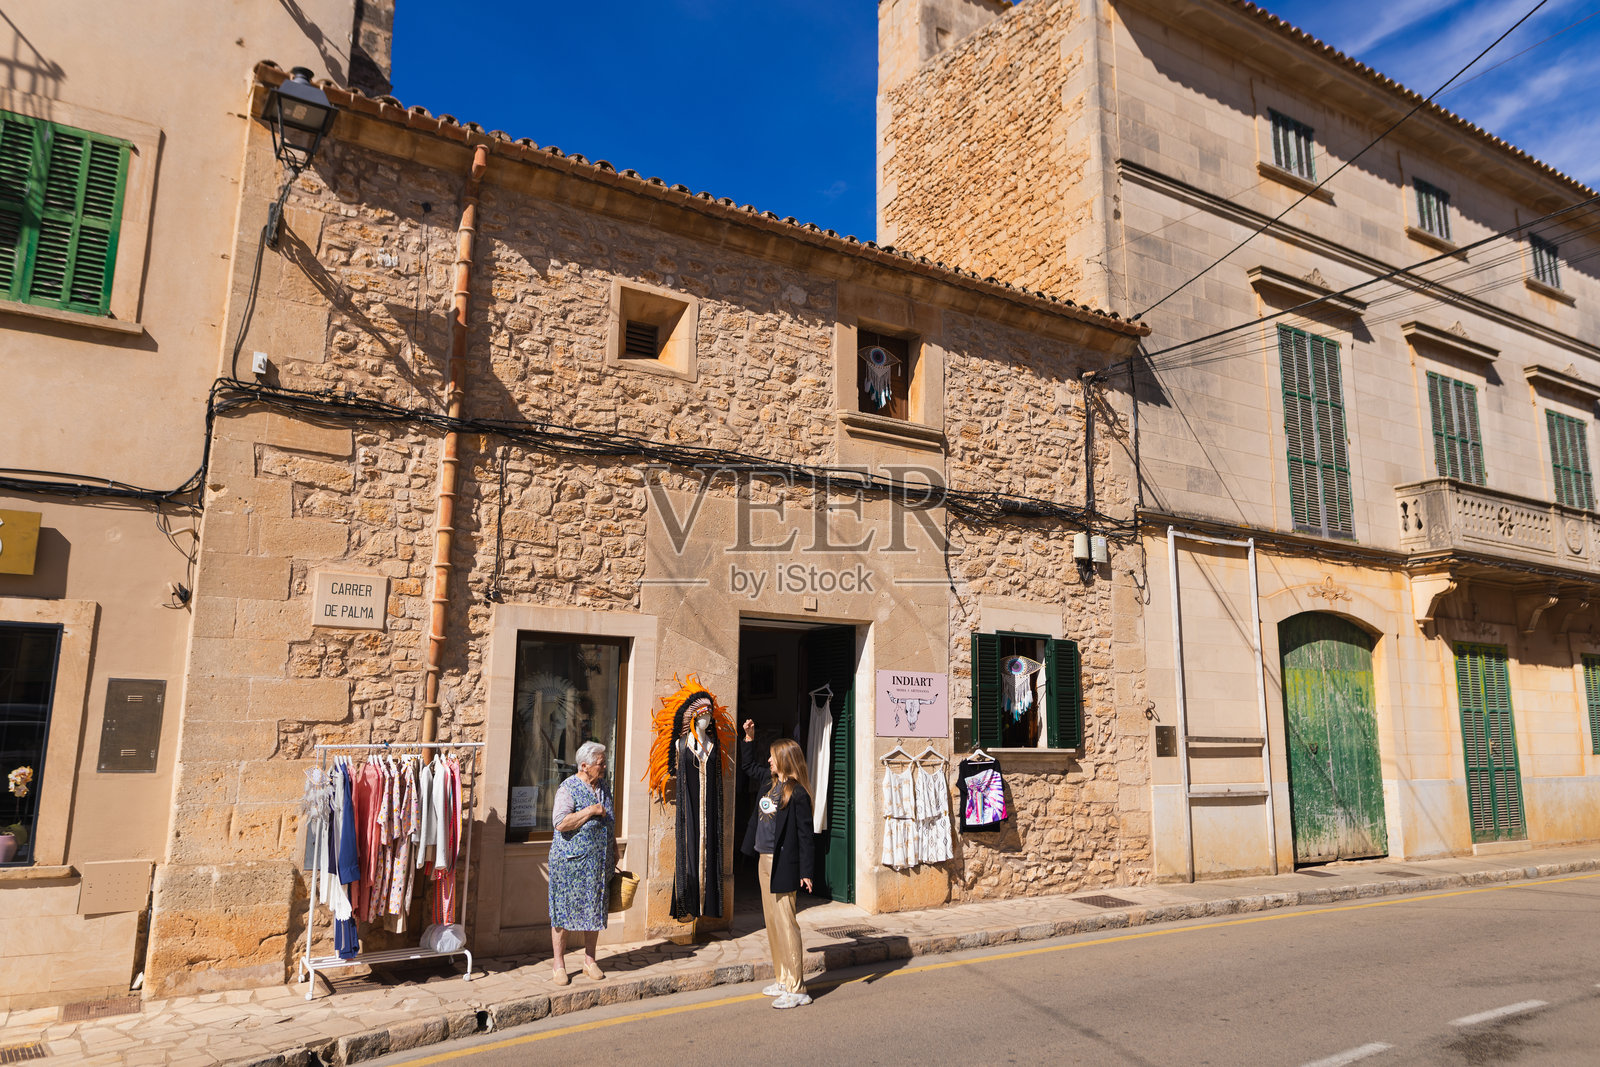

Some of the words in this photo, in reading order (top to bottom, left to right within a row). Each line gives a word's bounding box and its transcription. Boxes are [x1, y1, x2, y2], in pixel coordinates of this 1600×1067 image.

[331, 582, 373, 597] CARRER
[324, 604, 339, 617] DE
[341, 605, 374, 619] PALMA
[892, 675, 933, 687] INDIART
